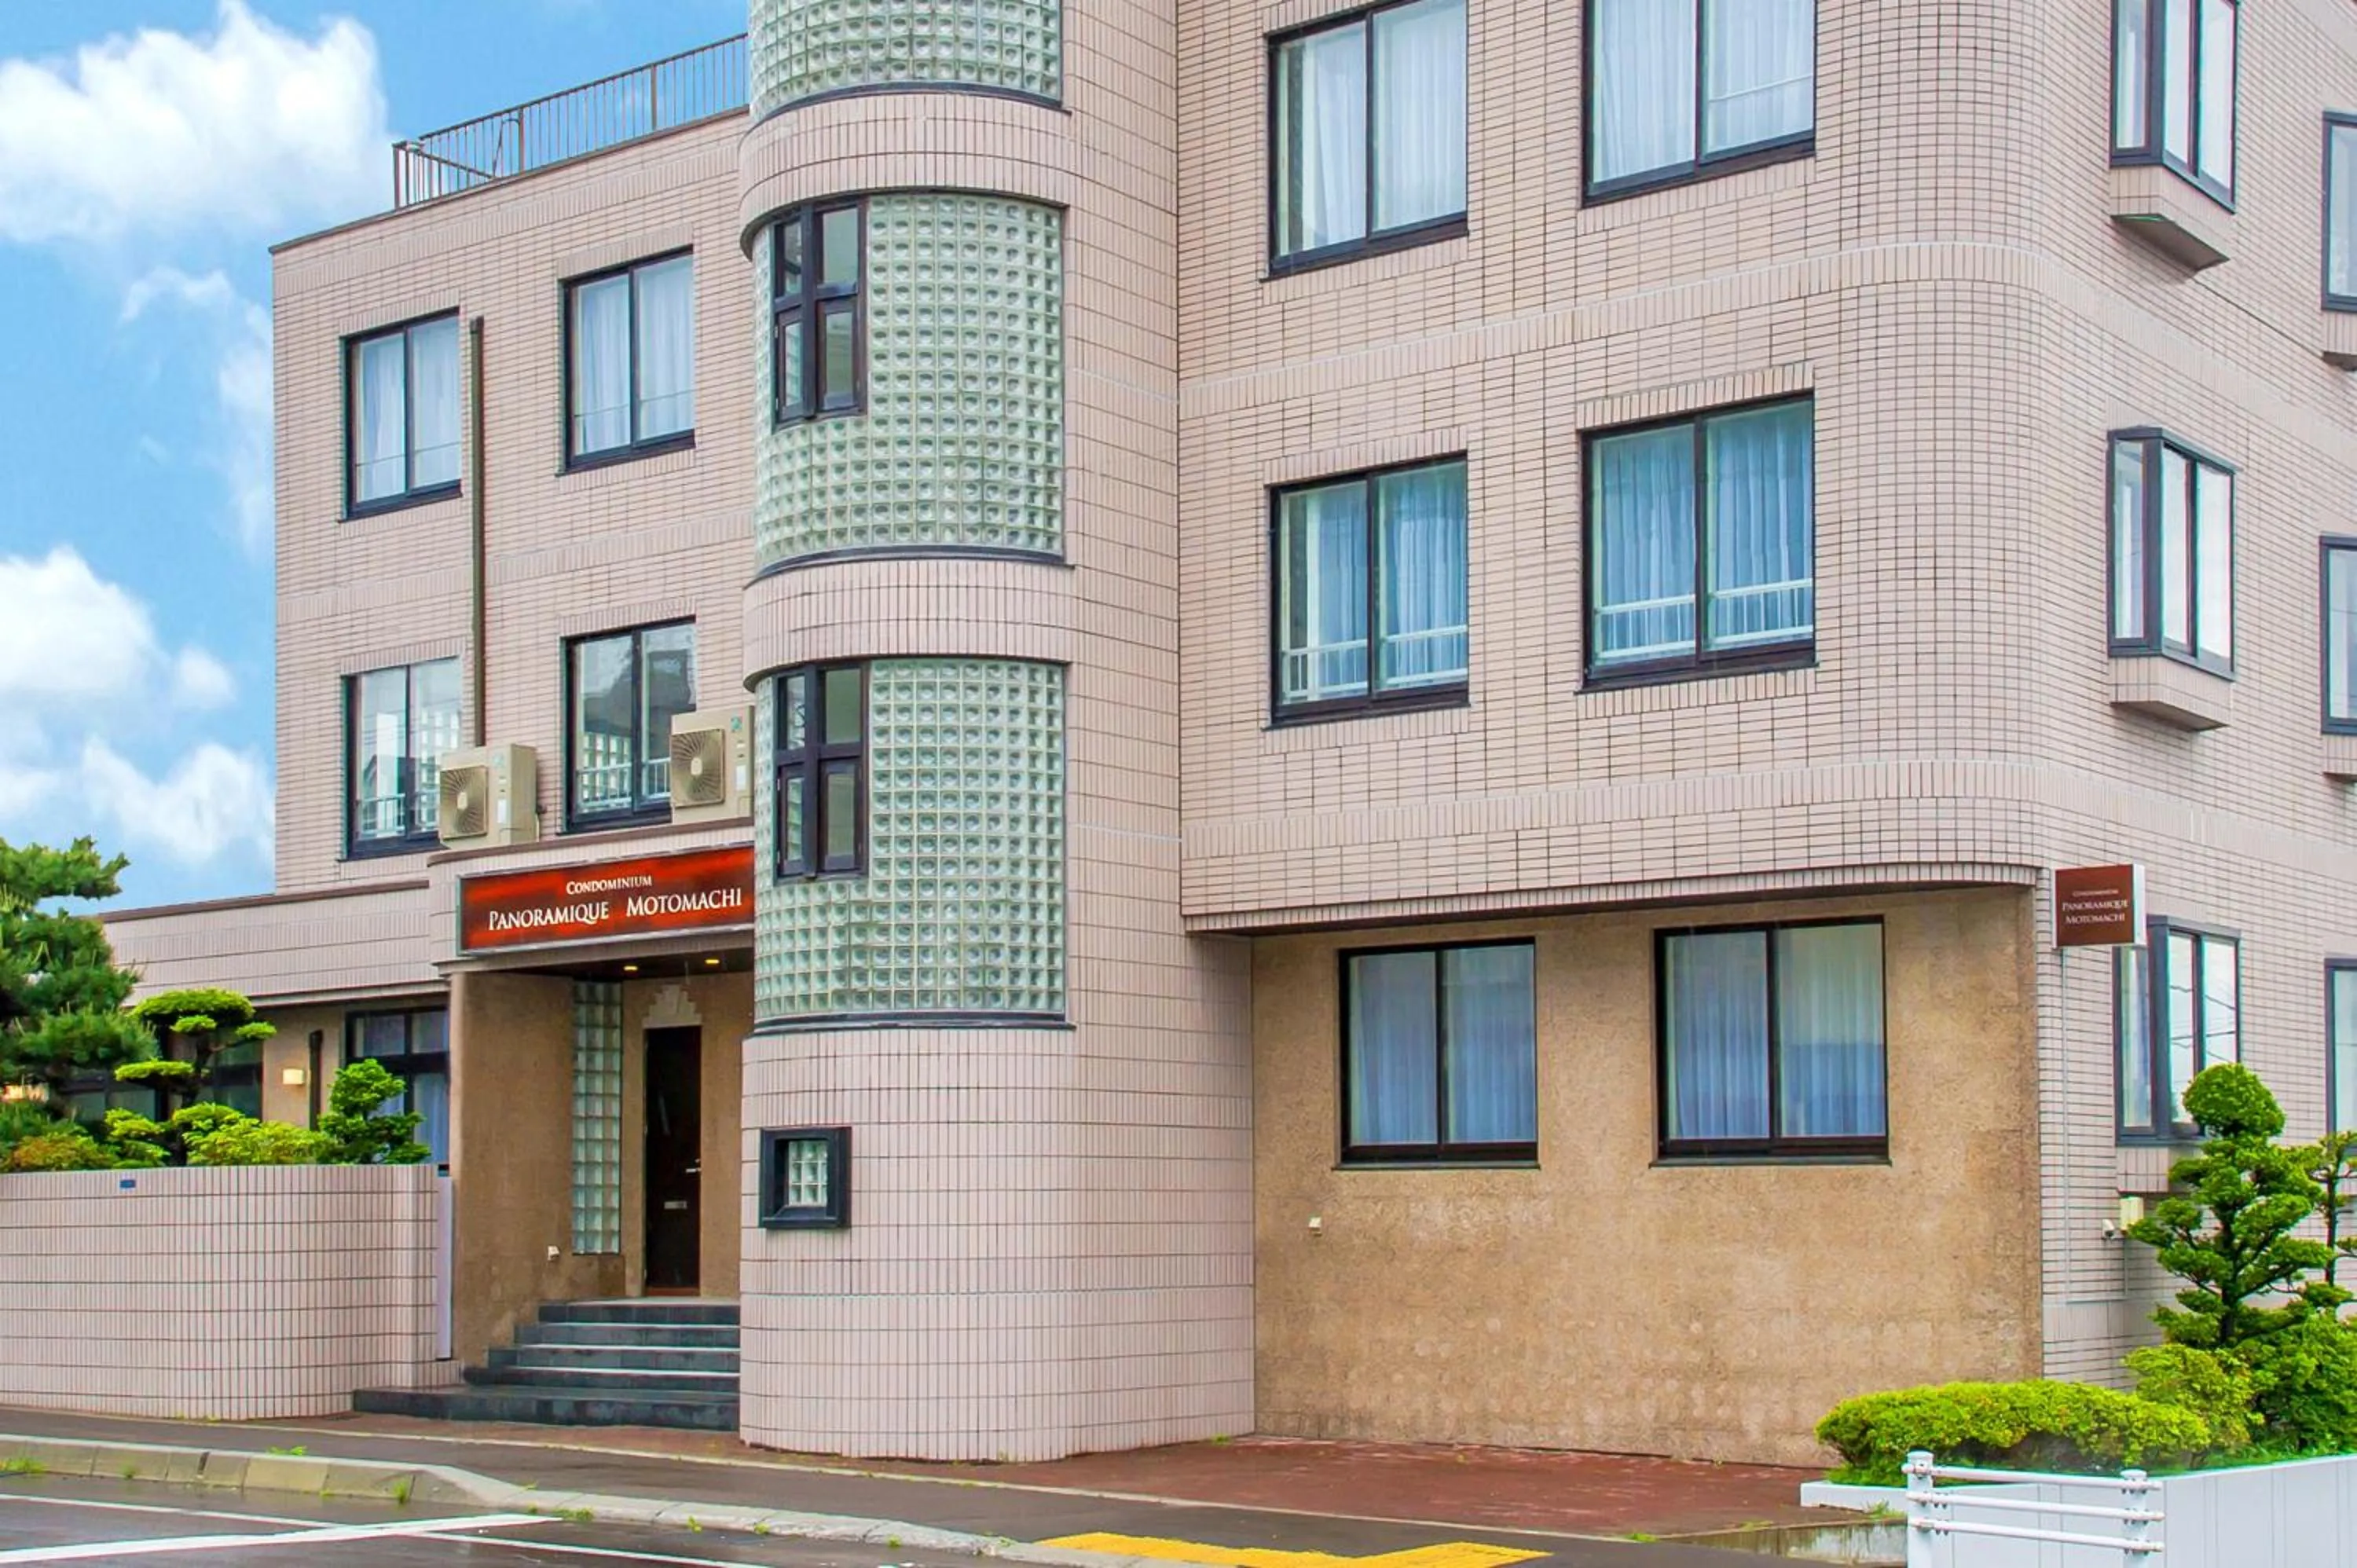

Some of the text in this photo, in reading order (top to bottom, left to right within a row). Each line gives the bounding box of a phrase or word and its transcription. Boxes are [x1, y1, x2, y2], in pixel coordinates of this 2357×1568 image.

[566, 875, 652, 895] CONDOMINIUM
[489, 888, 742, 931] PANORAMIQUE MOTOMACHI
